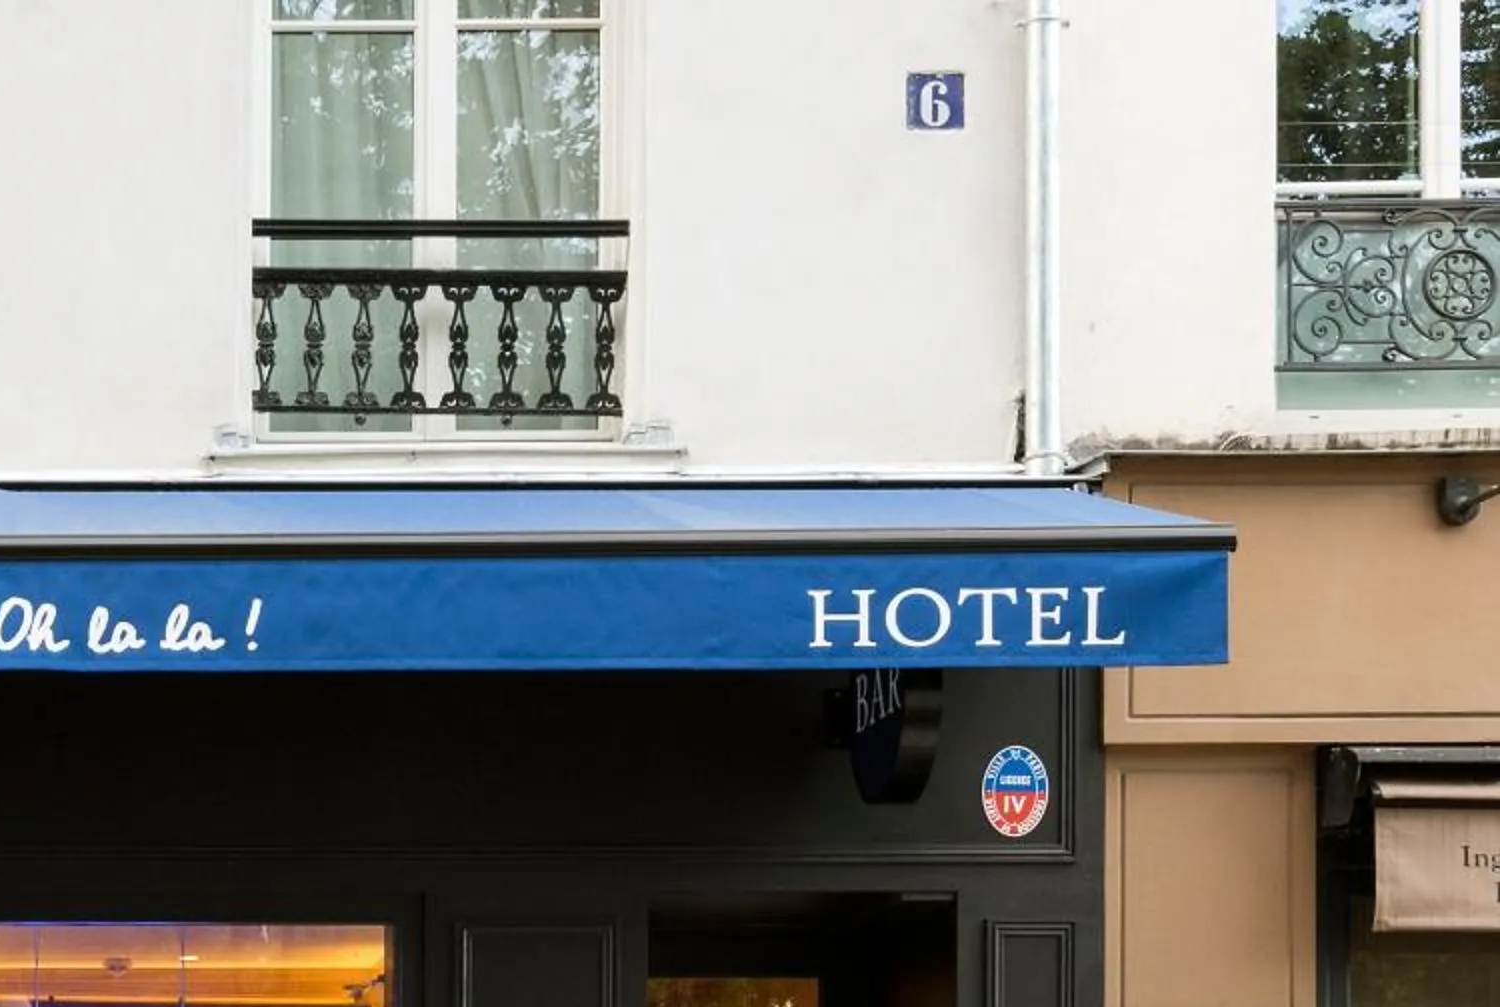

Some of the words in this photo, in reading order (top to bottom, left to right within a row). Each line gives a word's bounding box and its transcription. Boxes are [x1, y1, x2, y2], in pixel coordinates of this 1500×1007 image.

[920, 80, 951, 127] 6
[87, 605, 146, 653] la
[159, 603, 226, 652] la
[807, 587, 1126, 648] HOTEL
[855, 666, 902, 733] BAR
[1003, 795, 1027, 814] IV
